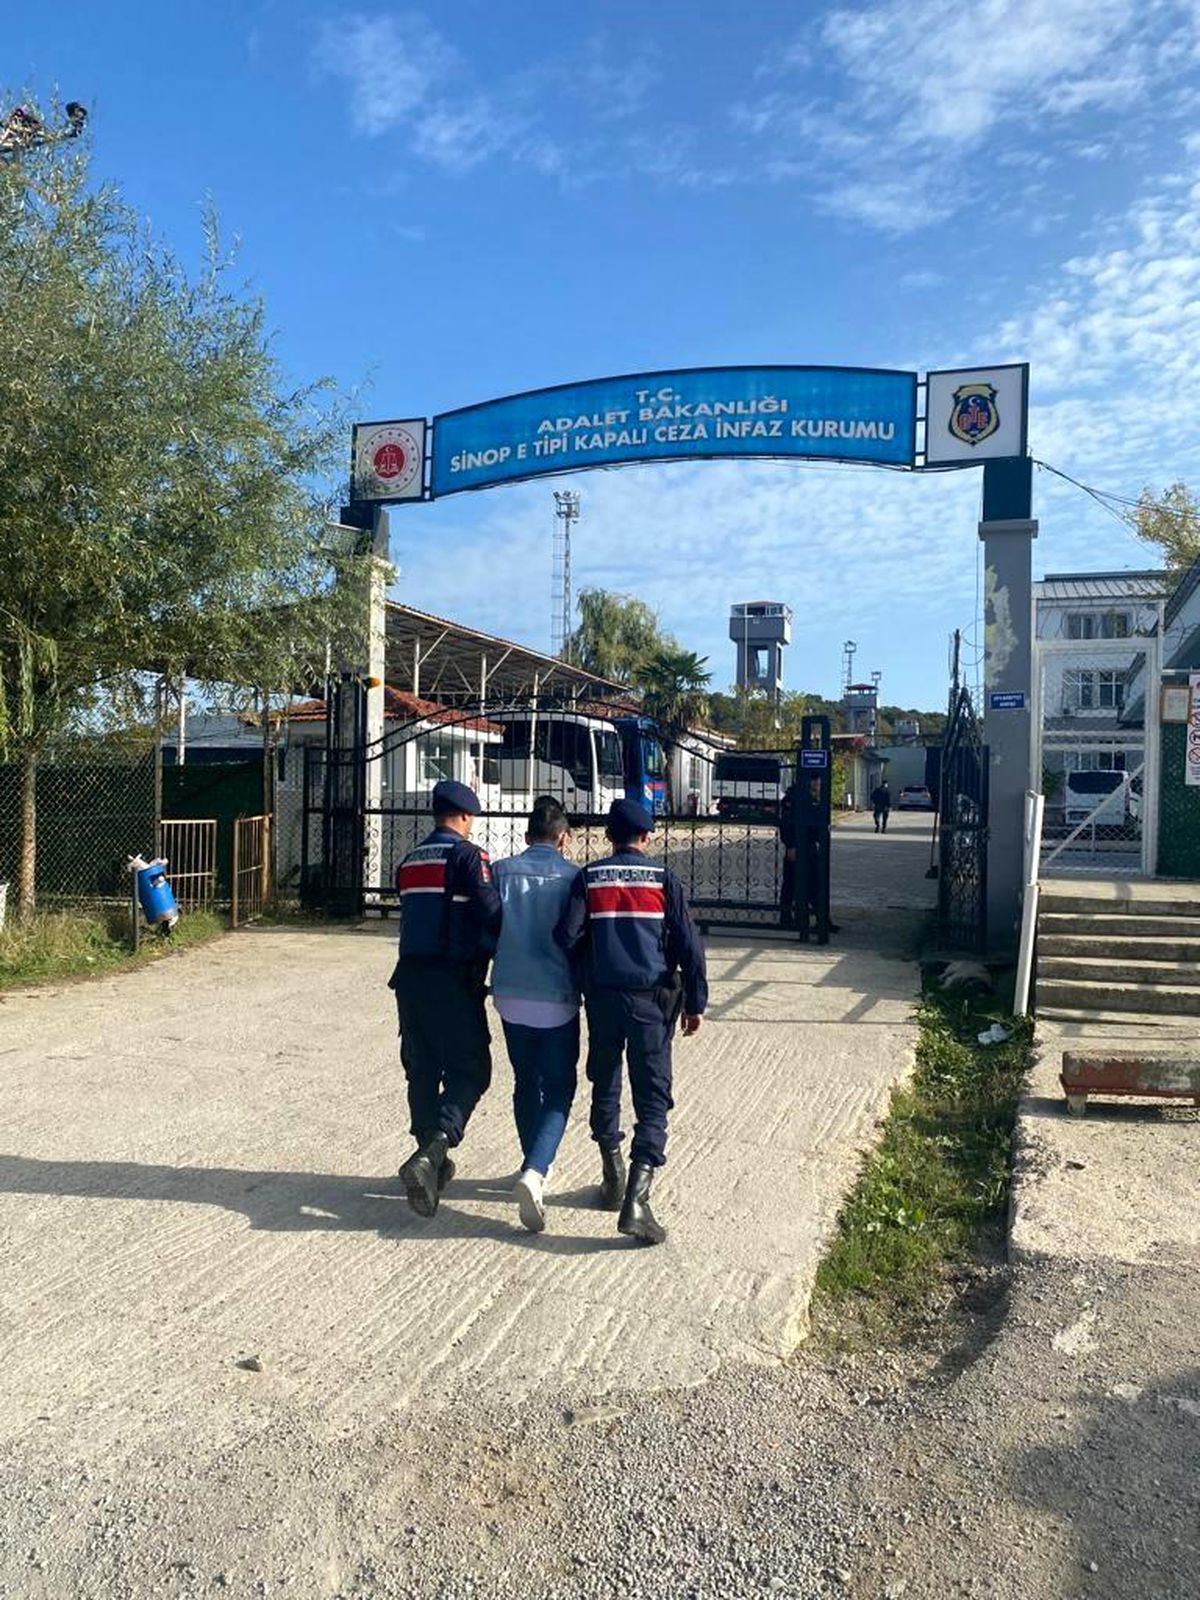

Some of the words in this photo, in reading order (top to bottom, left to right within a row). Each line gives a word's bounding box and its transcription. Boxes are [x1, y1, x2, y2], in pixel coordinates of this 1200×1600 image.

[636, 388, 681, 404] T.C.
[537, 410, 631, 434] ADALET
[638, 396, 788, 422] BAKANLIĞI
[450, 447, 511, 472] SİNOP
[517, 444, 527, 460] E
[533, 433, 567, 457] TİPİ
[574, 428, 647, 451] KAPALI
[654, 422, 709, 443] CEZA
[716, 417, 784, 438] İNFAZ
[791, 420, 895, 440] KURUMU
[595, 868, 656, 882] JANDARMA
